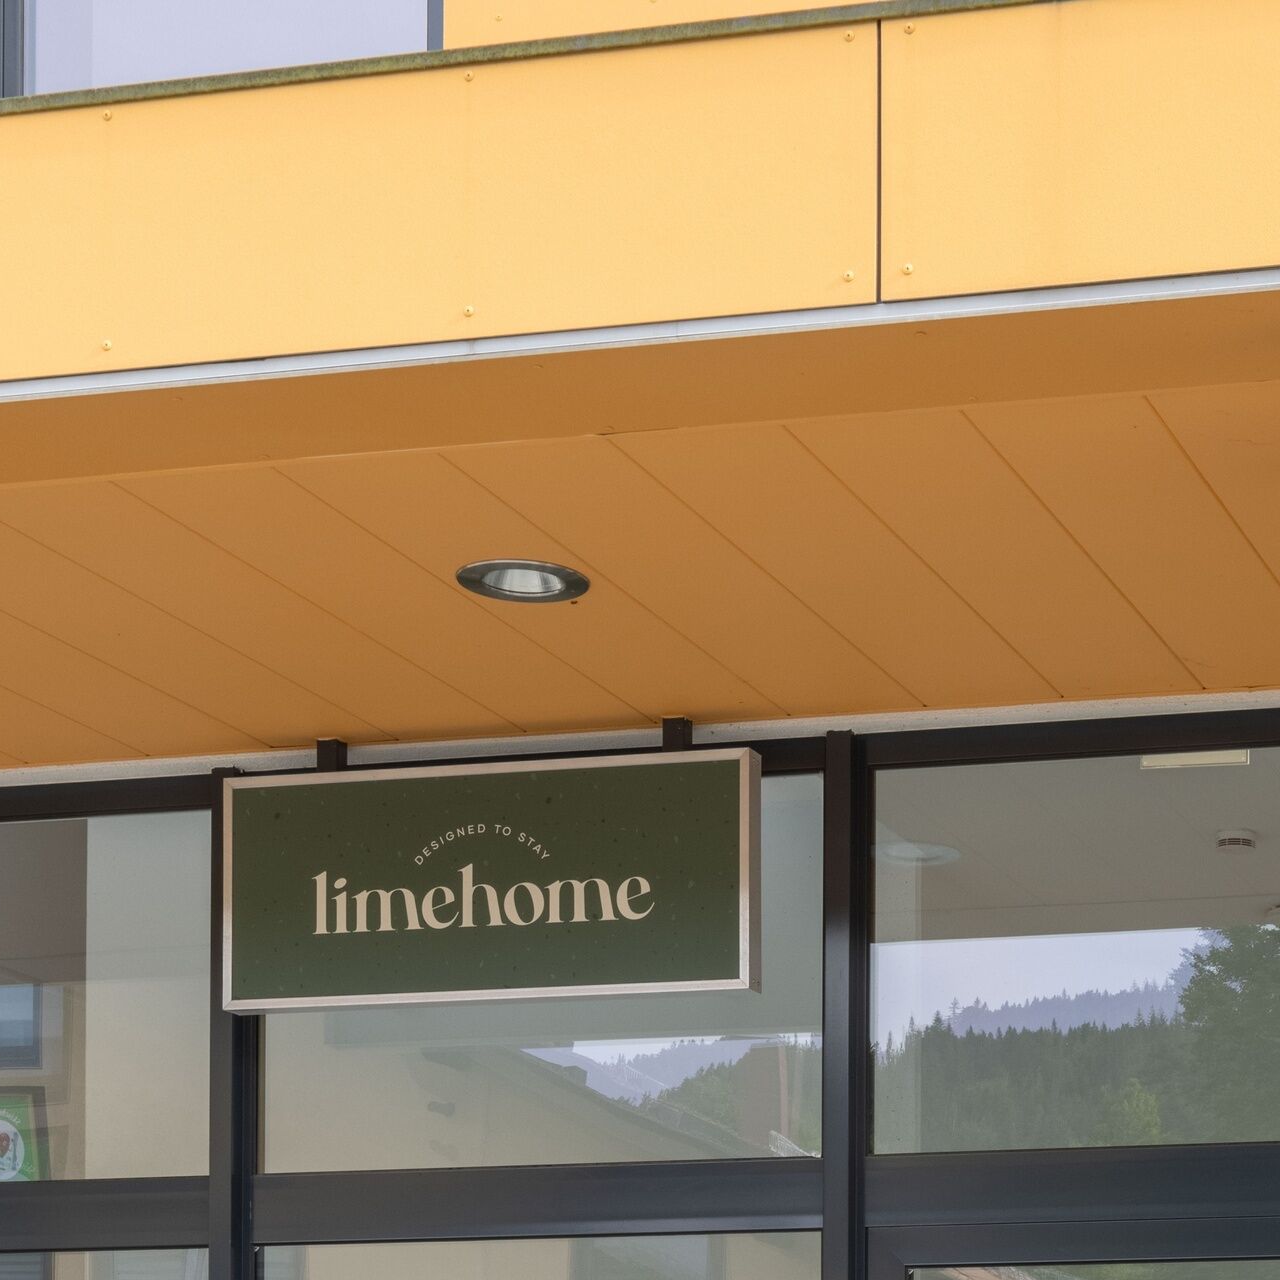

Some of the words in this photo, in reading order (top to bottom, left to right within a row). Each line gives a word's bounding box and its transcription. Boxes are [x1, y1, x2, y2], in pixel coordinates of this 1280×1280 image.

[414, 823, 486, 866] DESIGNED
[494, 824, 512, 836] TO
[518, 832, 550, 860] STAY
[311, 863, 655, 935] limehome
